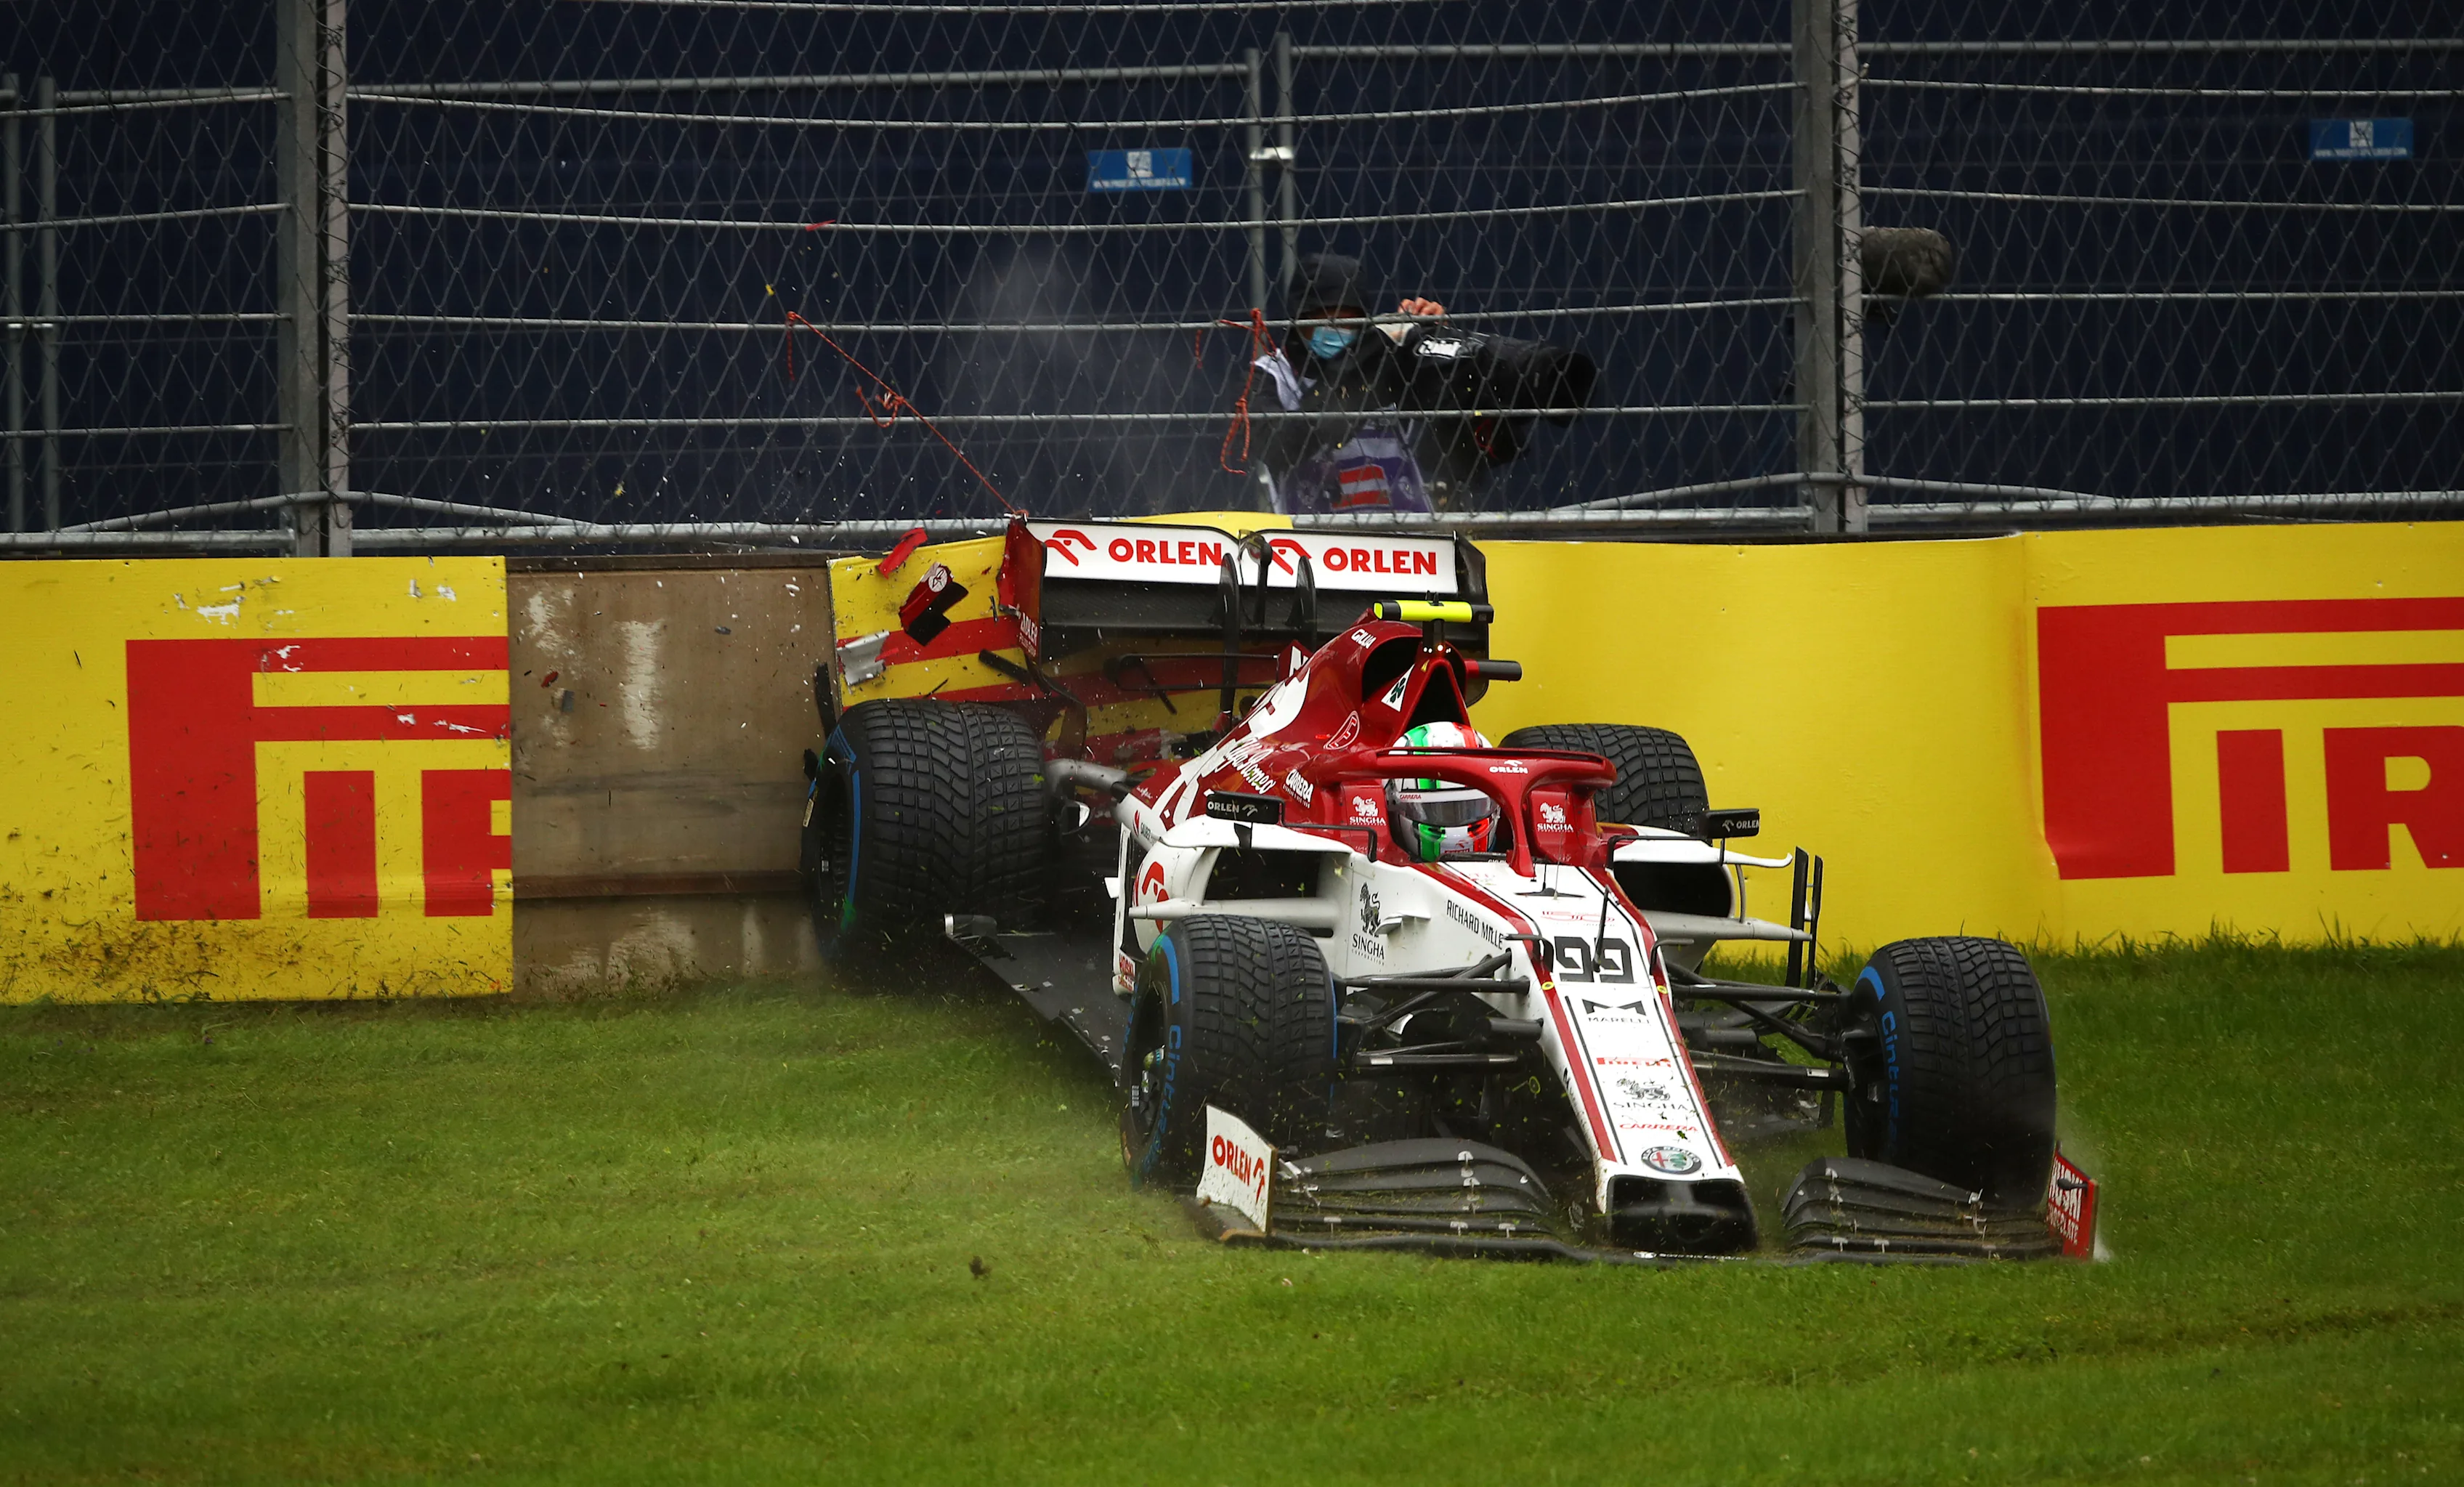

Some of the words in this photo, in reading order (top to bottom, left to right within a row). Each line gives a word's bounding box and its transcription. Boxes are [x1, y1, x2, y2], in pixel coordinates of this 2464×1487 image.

[1109, 538, 1223, 566] ORLEN
[1324, 547, 1437, 575] ORLEN
[1286, 769, 1313, 803] CARRERA
[1207, 801, 1239, 813] ORLEN
[1350, 817, 1387, 825] SINGHA
[1446, 899, 1480, 935] RICHARD
[1481, 921, 1504, 950] MILLE
[1352, 933, 1385, 960] SINGHA
[1554, 936, 1634, 984] 99
[1619, 1123, 1698, 1132] CARRERA
[1212, 1135, 1251, 1186] ORLEN
